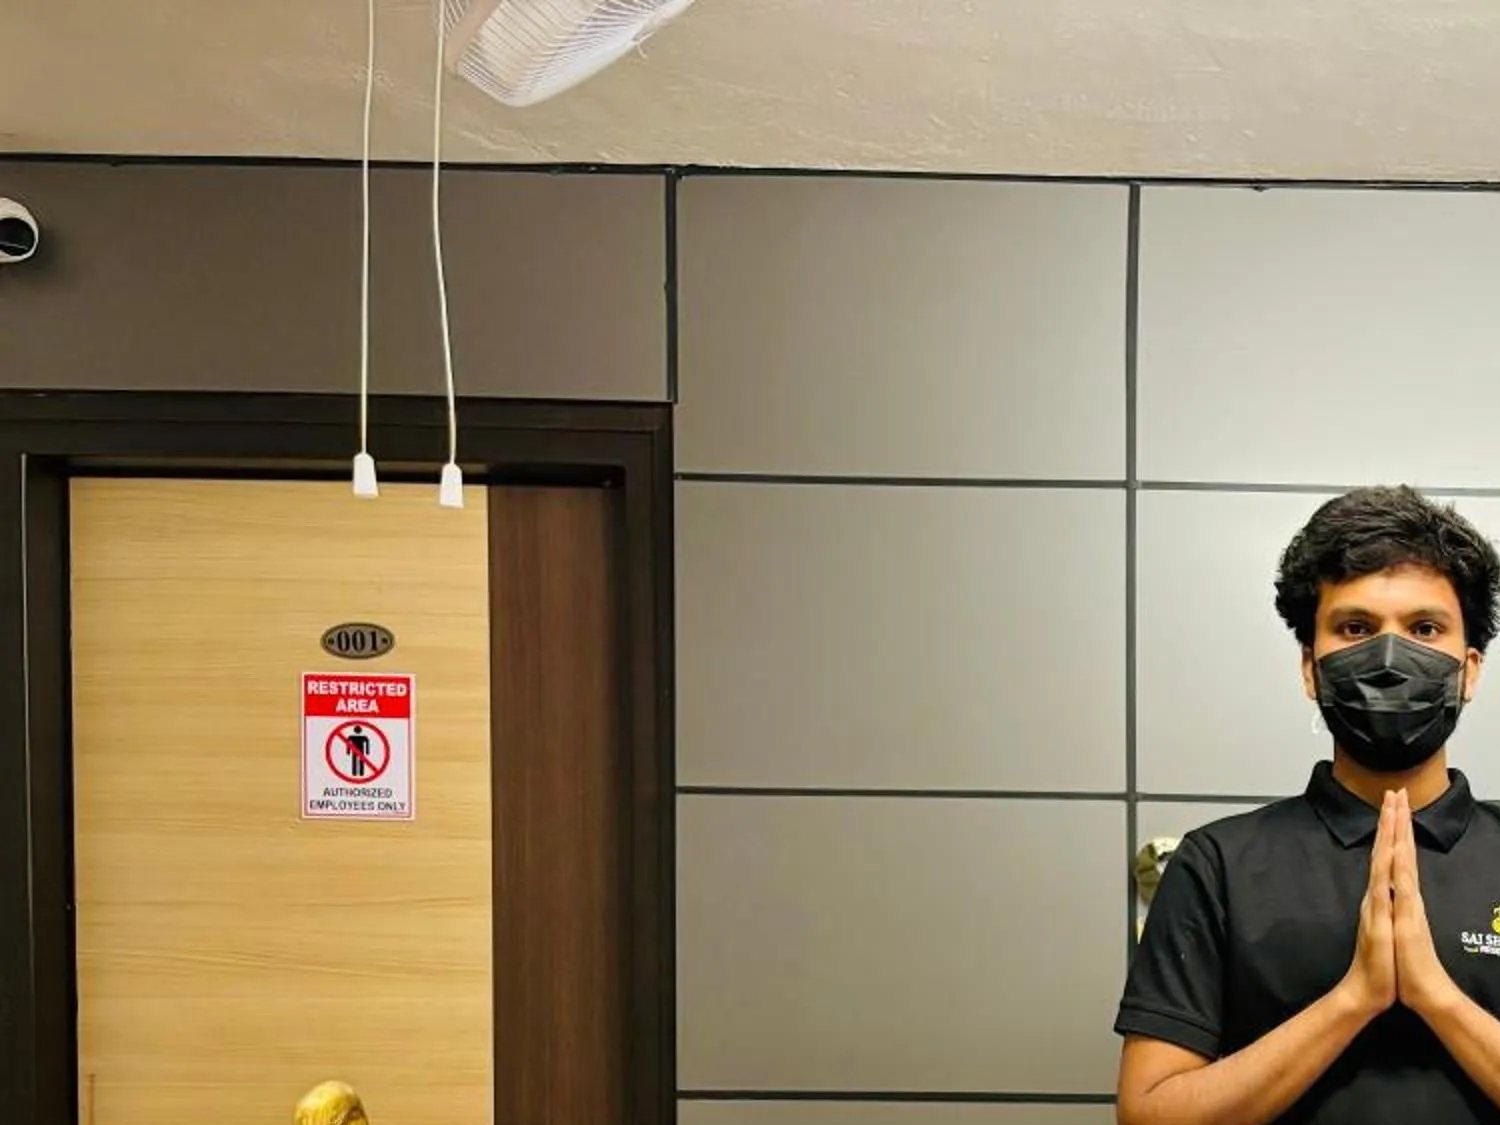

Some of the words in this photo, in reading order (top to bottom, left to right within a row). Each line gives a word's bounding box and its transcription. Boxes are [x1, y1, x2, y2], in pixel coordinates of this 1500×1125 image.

[337, 630, 379, 651] 001
[307, 681, 407, 696] RESTRICTED
[336, 699, 379, 712] AREA
[323, 787, 392, 798] AUTHORIZED
[309, 800, 375, 811] EMPLOYEES
[378, 801, 405, 811] ONLY
